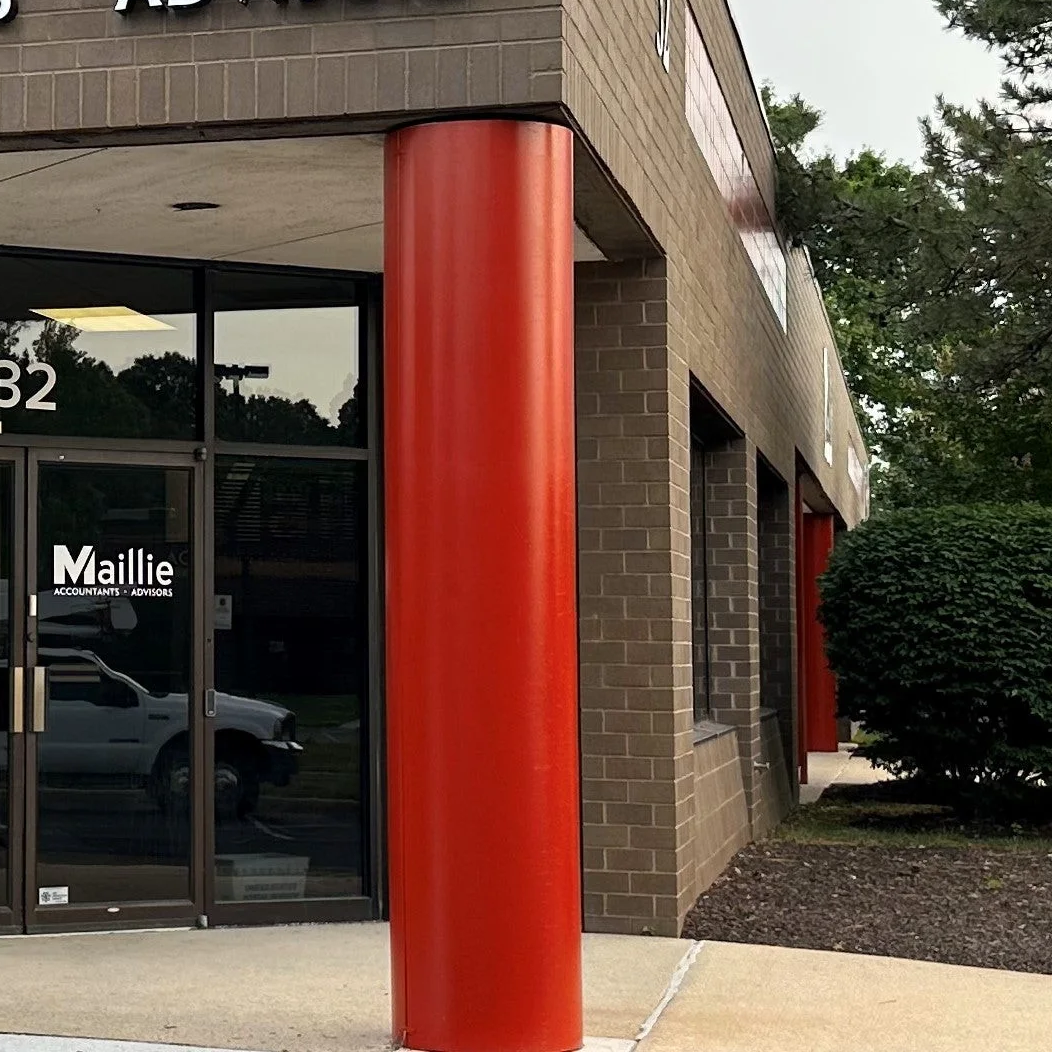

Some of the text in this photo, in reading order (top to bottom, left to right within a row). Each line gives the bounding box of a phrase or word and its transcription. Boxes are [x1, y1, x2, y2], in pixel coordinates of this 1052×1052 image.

[53, 544, 174, 586] Maillie
[53, 587, 173, 597] ACCOUNTANTS ADVISORS
